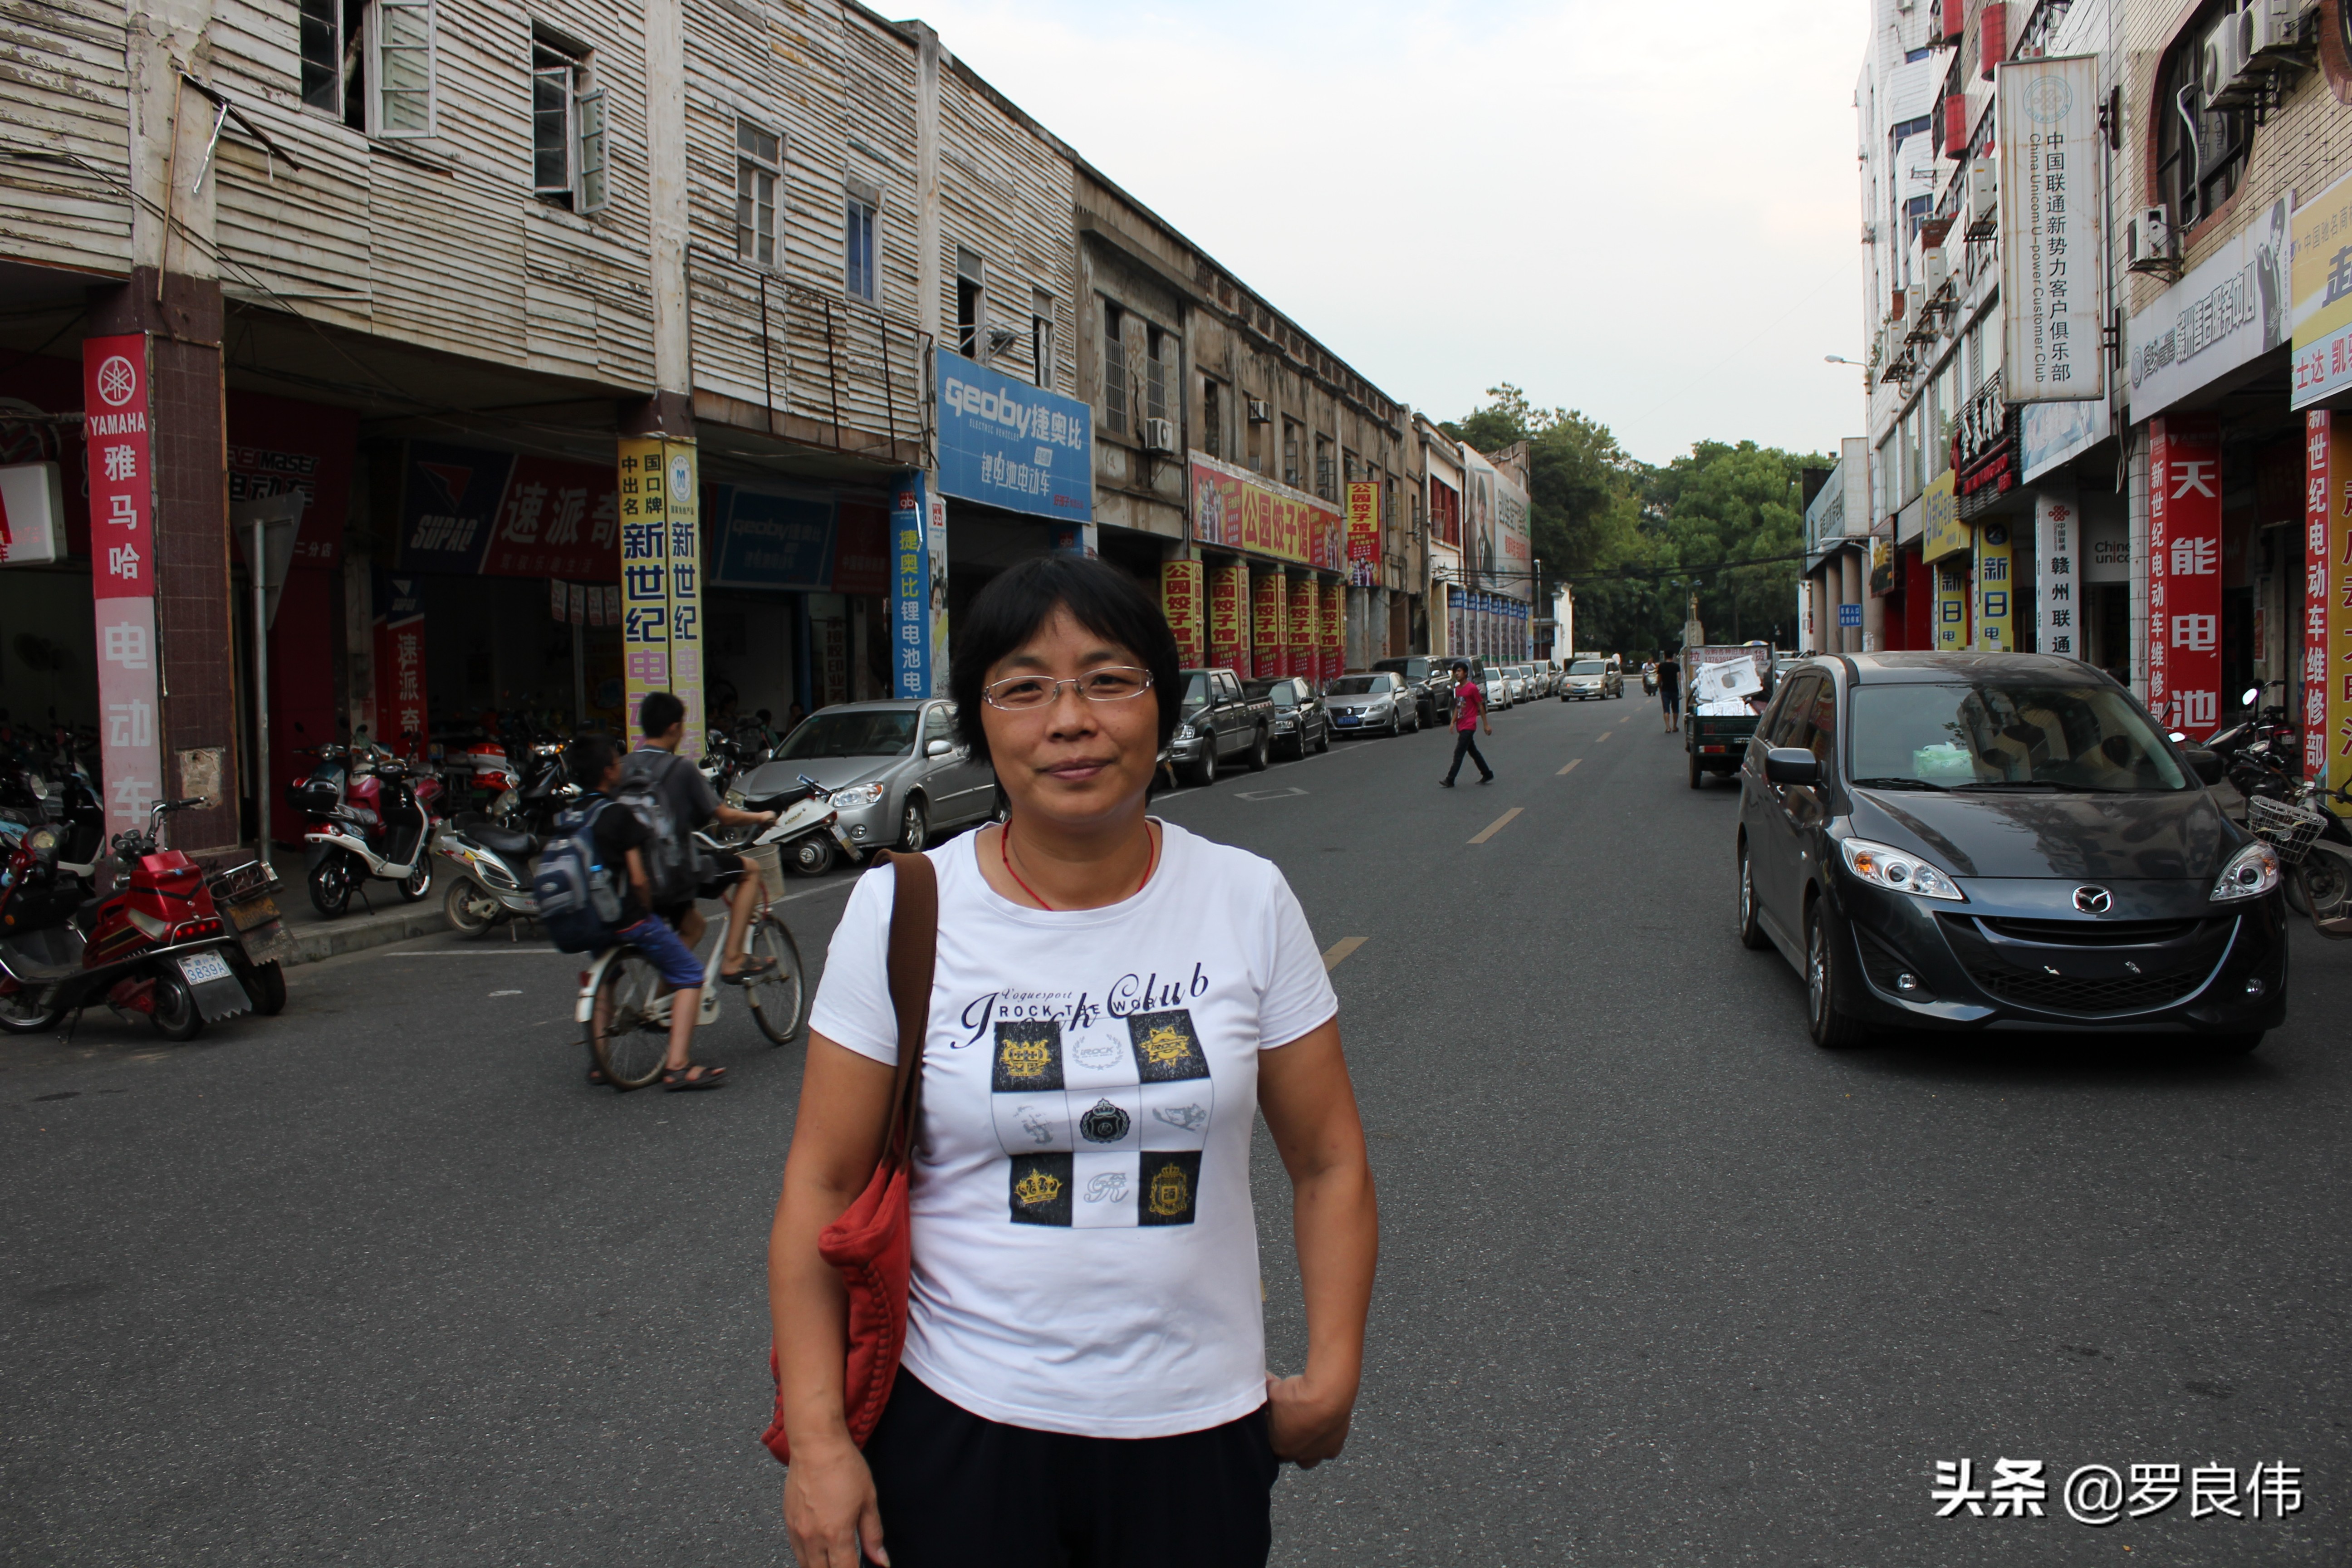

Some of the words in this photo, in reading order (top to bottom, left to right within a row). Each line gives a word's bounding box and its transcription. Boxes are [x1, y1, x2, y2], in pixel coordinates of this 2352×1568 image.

[2029, 132, 2041, 171] China
[2031, 174, 2041, 221] Unicom
[2030, 226, 2041, 280] U-power
[2046, 131, 2071, 383] 中国联通新势力客户俱乐部
[2033, 284, 2043, 351] Customer
[2034, 353, 2046, 383] Club
[2292, 348, 2325, 394] 士达
[90, 412, 146, 436] YAMAHA
[945, 377, 1031, 439] geoby
[1031, 403, 1081, 450] 捷奥比
[969, 418, 993, 434] ELECTRIC
[996, 426, 1019, 442] VEHICLES
[981, 451, 1050, 497] 锂电池电动车
[104, 444, 140, 580] 雅马哈
[500, 481, 618, 549] 速派奇
[1244, 489, 1308, 559] 公园饺子馆
[1352, 484, 1371, 531] 公园饺子馆
[899, 529, 921, 699] 捷奥比锂电池电
[1166, 564, 1192, 642] 公园饺子馆
[1212, 569, 1236, 642] 公园饺子馆
[1255, 578, 1275, 643] 公园饺子馆
[1290, 583, 1310, 643] 公园饺子馆
[1321, 588, 1338, 645] 公园饺子馆
[1984, 557, 2008, 640] 新日电
[2051, 557, 2071, 653] 赣州联通
[2150, 460, 2164, 723] 新世纪电动车维修部
[2171, 460, 2216, 727] 天能电池
[623, 521, 668, 753] 新世纪电
[1754, 650, 1764, 661] 货
[105, 622, 153, 823] 电动车
[187, 962, 226, 980] 3839A
[1107, 962, 1209, 1019] Club
[1000, 1005, 1051, 1017] ROCK
[1065, 1003, 1100, 1016] THE
